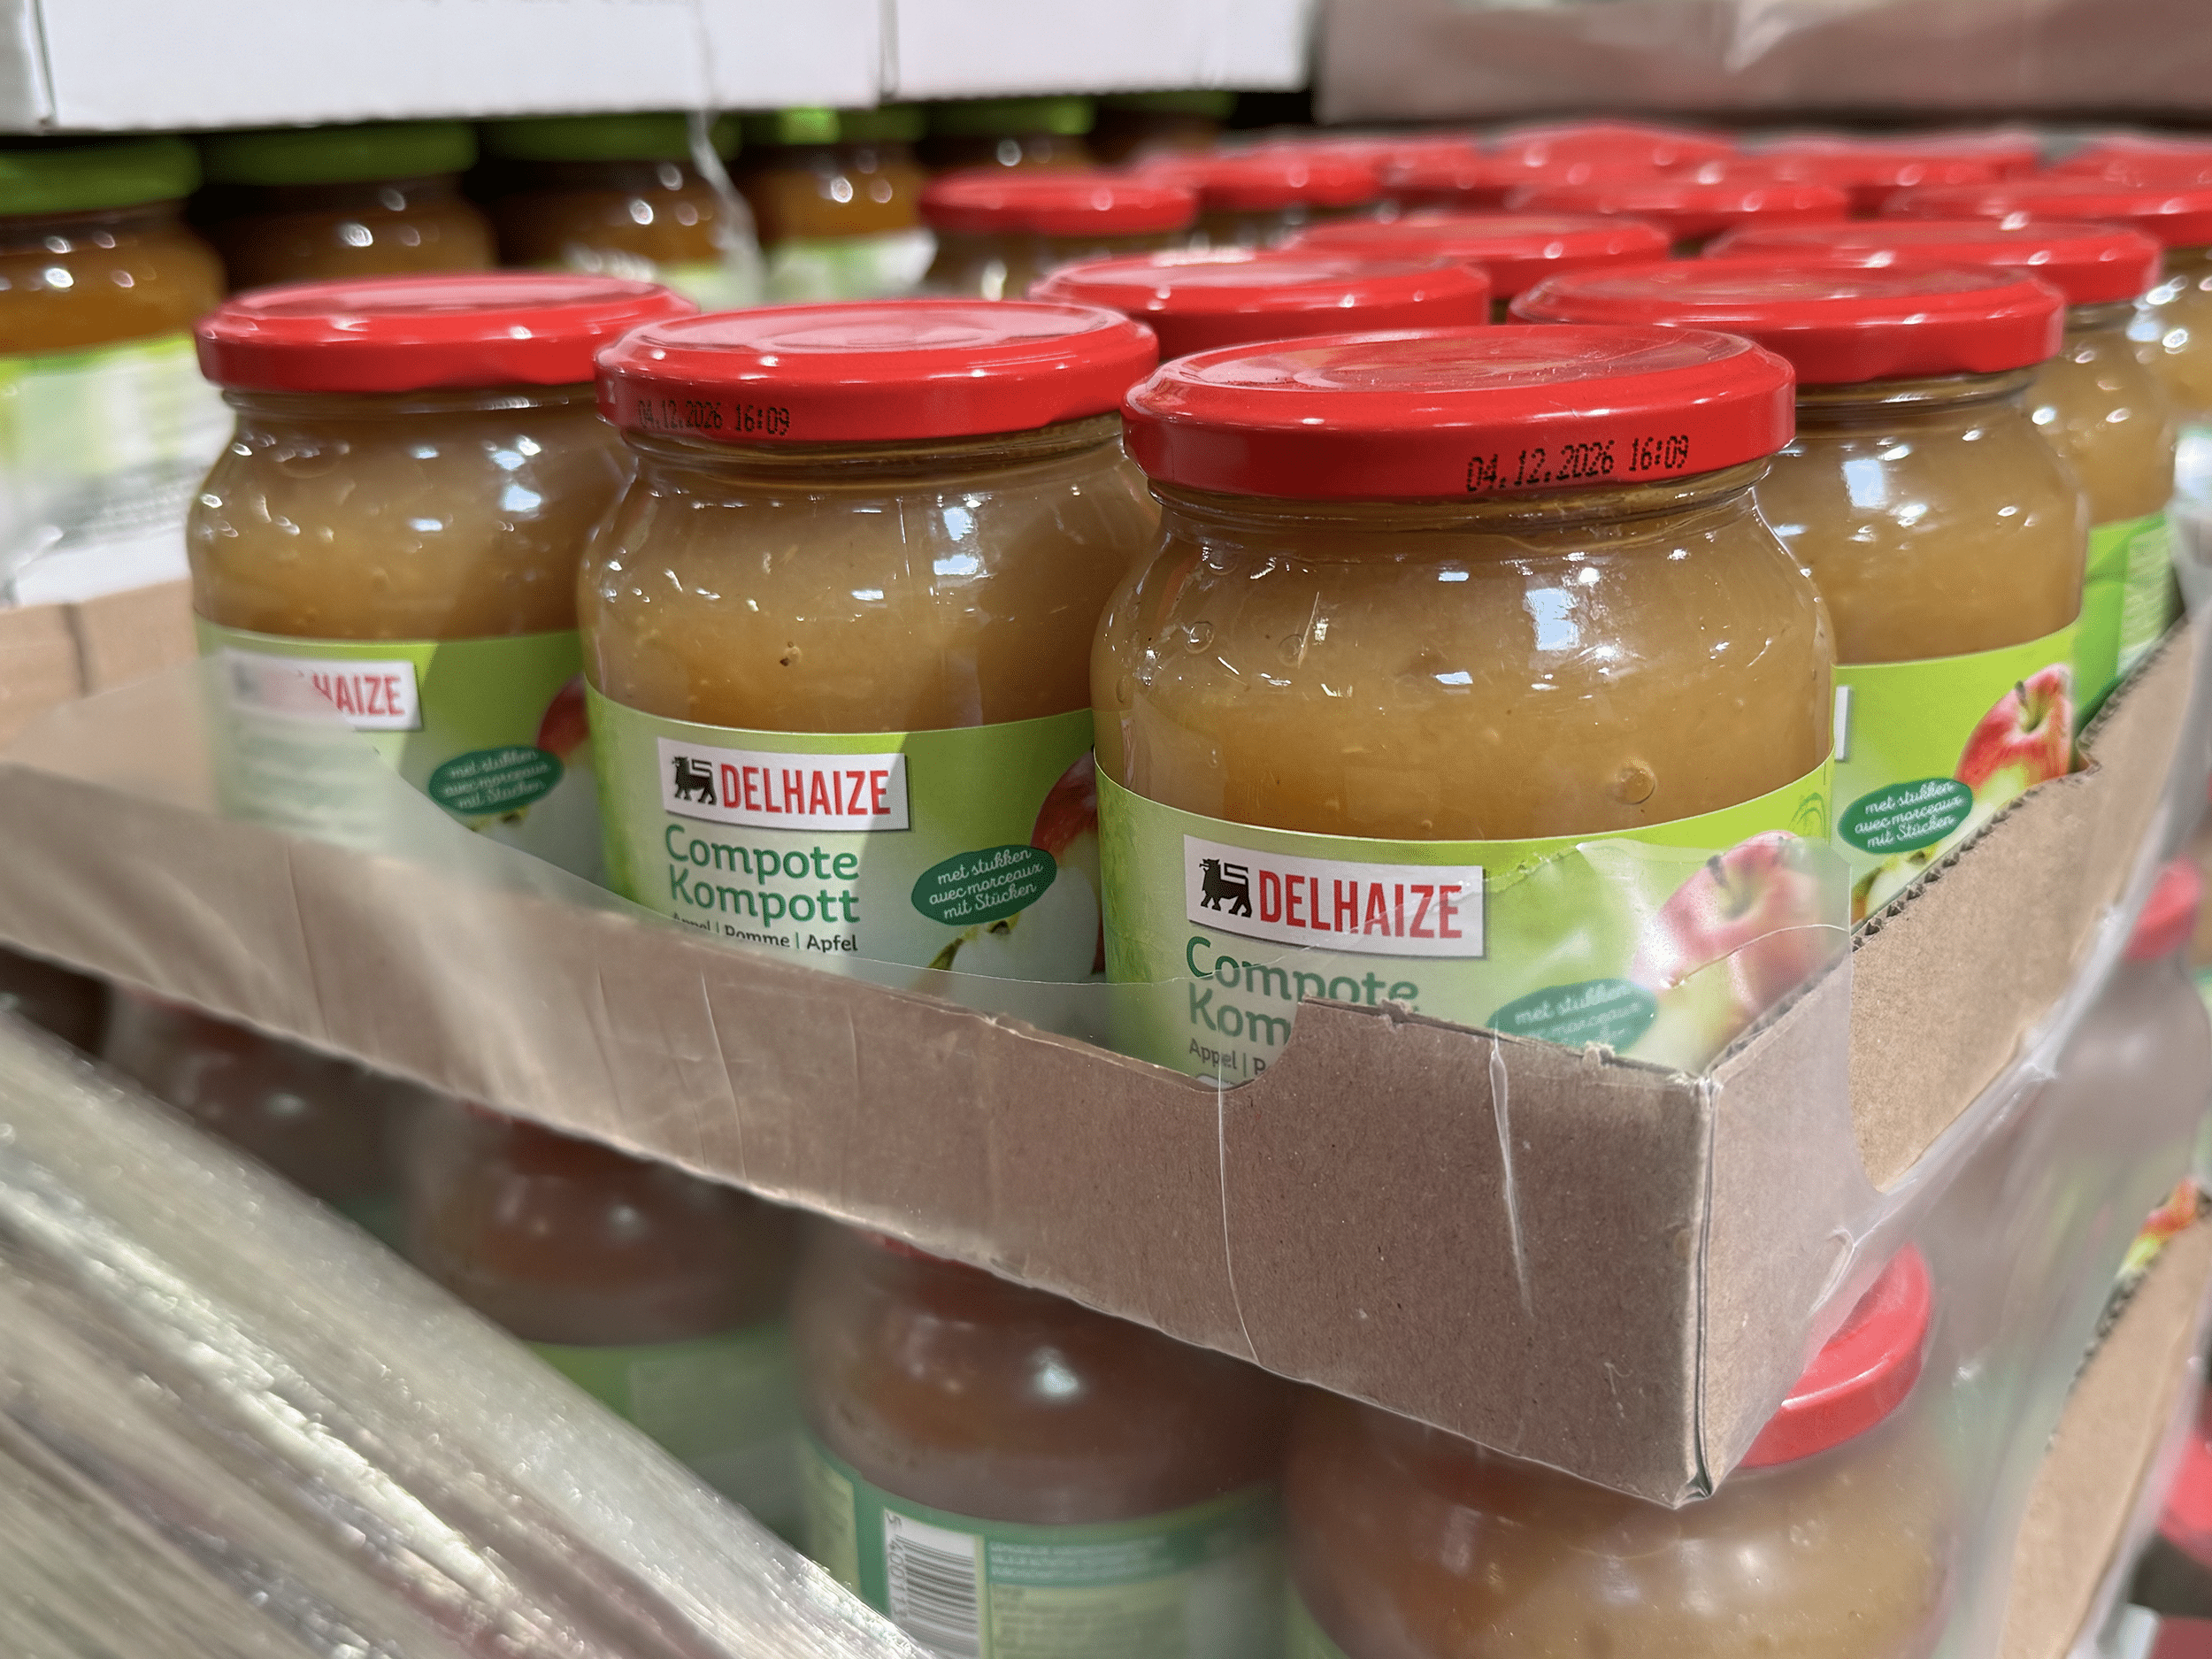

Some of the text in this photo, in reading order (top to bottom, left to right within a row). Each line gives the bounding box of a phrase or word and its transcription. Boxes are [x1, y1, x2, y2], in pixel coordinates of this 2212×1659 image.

[638, 400, 790, 435] 04.12.2026 16:09
[1466, 435, 1689, 491] 04.12.2026 16:09
[721, 763, 891, 816] DELHAIZE
[1865, 795, 1896, 814] met
[664, 824, 859, 884] Compote
[938, 849, 1031, 885] met stukken
[669, 864, 860, 927] Kompott
[967, 863, 1043, 895] morceaux
[943, 882, 1037, 918] mit Stücken
[1259, 870, 1463, 940] DELHAIZE
[806, 934, 858, 953] Apfel
[1189, 1038, 1237, 1070] Appel
